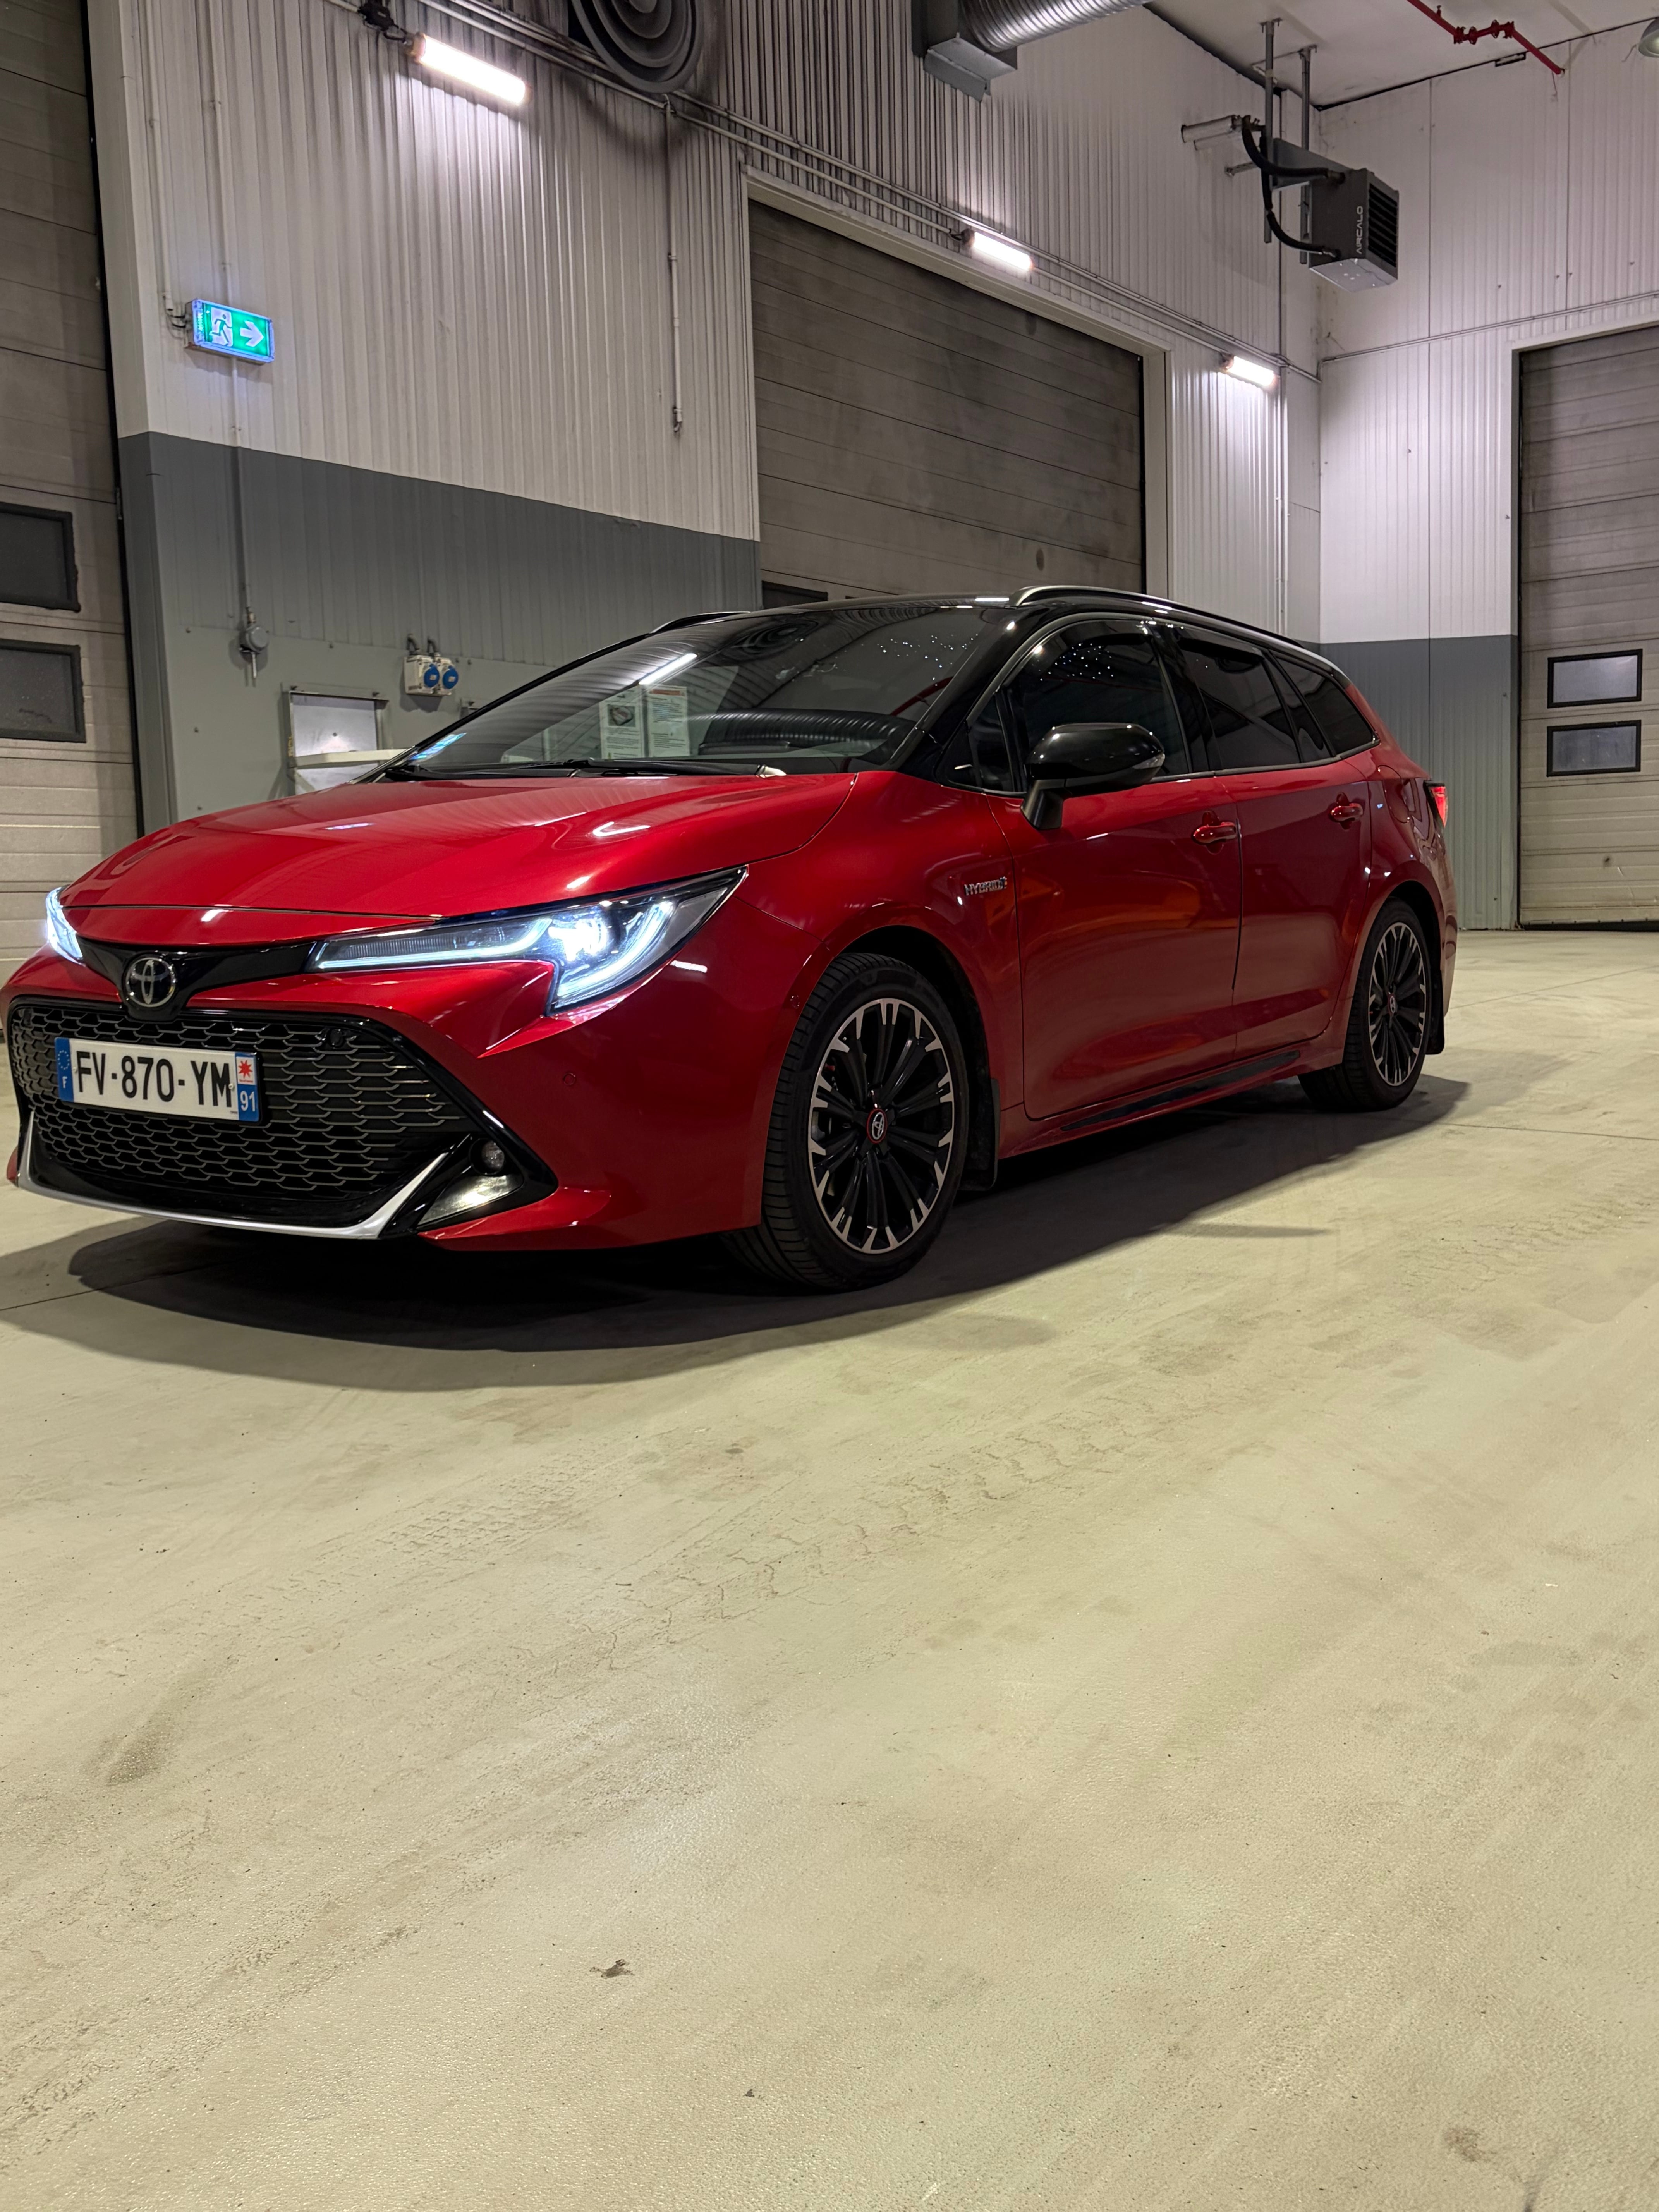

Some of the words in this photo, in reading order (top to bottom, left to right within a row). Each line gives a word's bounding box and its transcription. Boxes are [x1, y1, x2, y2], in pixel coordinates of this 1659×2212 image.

[964, 879, 1003, 896] HYBRID
[62, 1076, 68, 1089] F
[76, 1051, 232, 1108] FV-870-YM
[240, 1091, 256, 1112] 91
